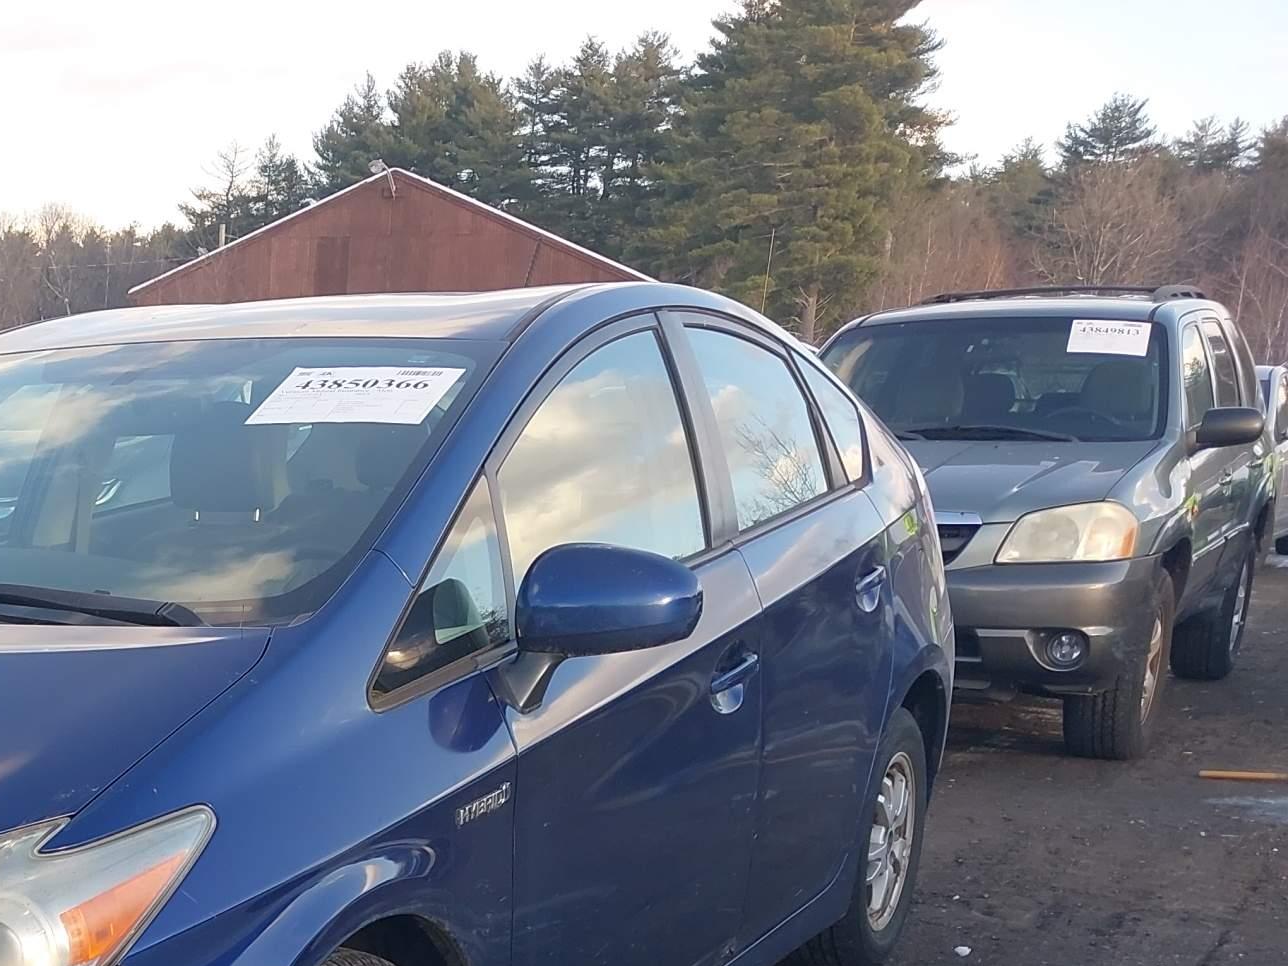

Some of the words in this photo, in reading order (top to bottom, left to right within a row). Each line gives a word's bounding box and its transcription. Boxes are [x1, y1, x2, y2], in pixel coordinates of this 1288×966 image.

[1079, 326, 1140, 336] 43849813
[295, 379, 429, 389] 43850366
[455, 782, 512, 826] HYBRID
